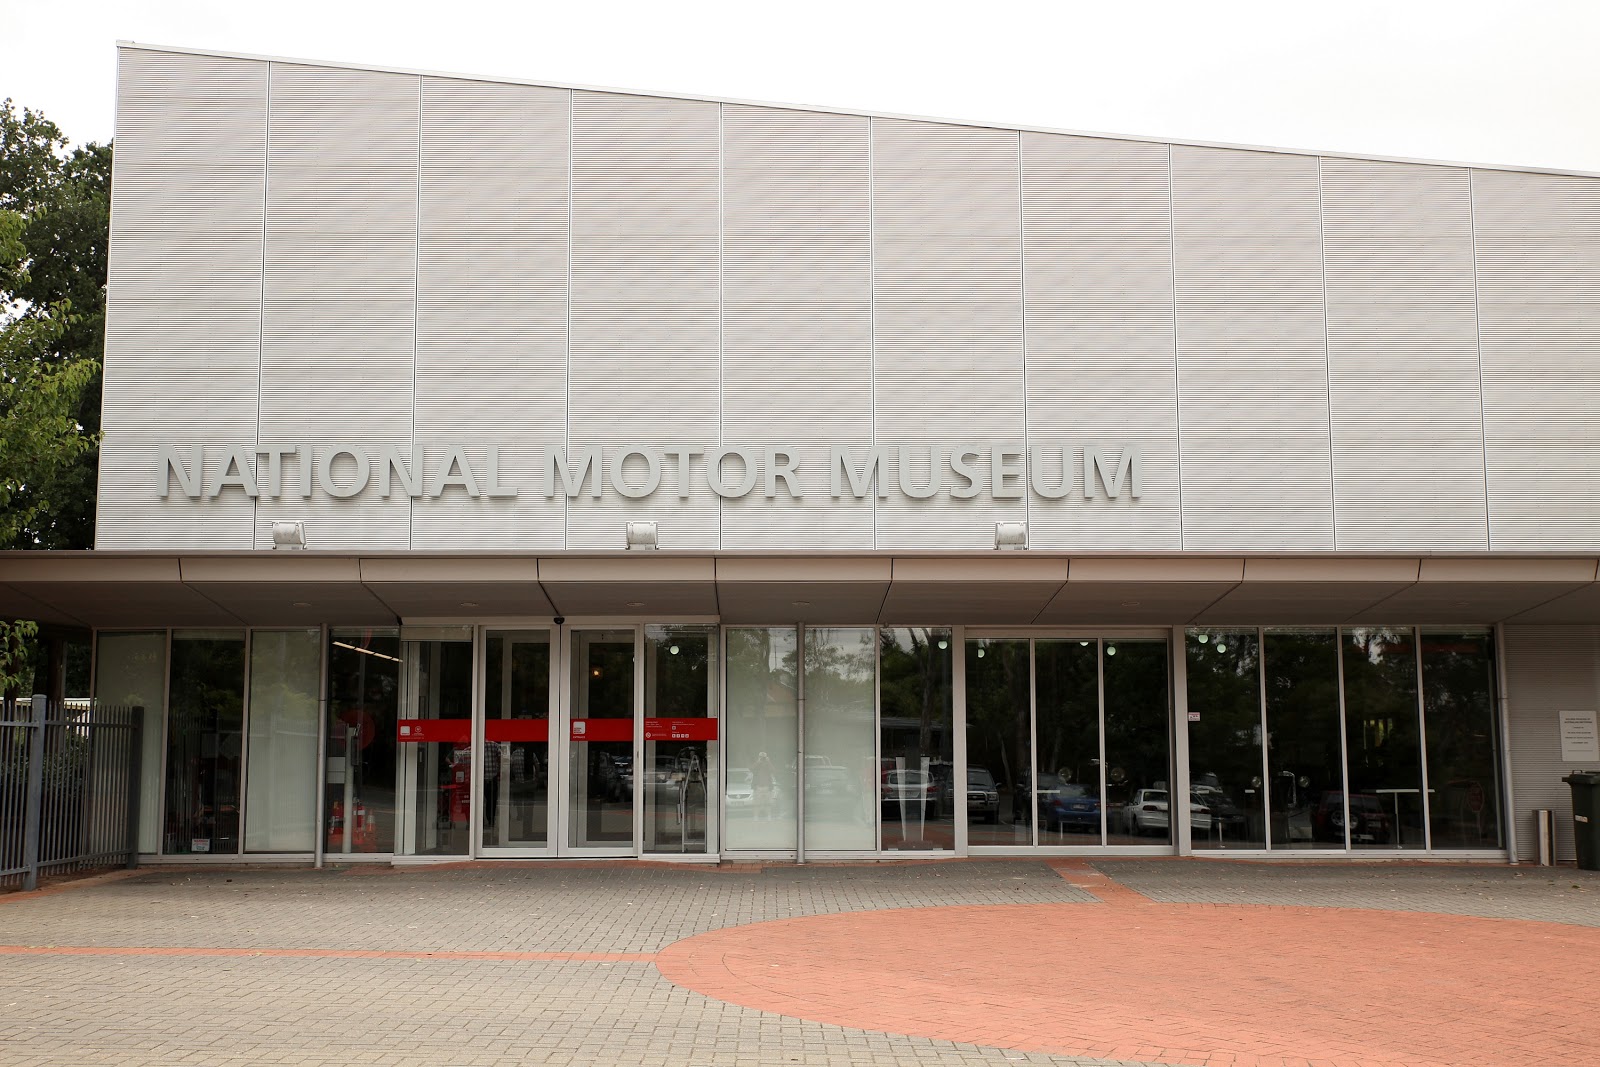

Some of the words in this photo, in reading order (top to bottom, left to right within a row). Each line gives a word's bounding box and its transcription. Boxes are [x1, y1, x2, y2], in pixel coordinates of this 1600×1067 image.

[156, 443, 518, 498] NATIONAL
[543, 443, 802, 499] MOTOR
[831, 443, 1141, 499] MUSEUM
